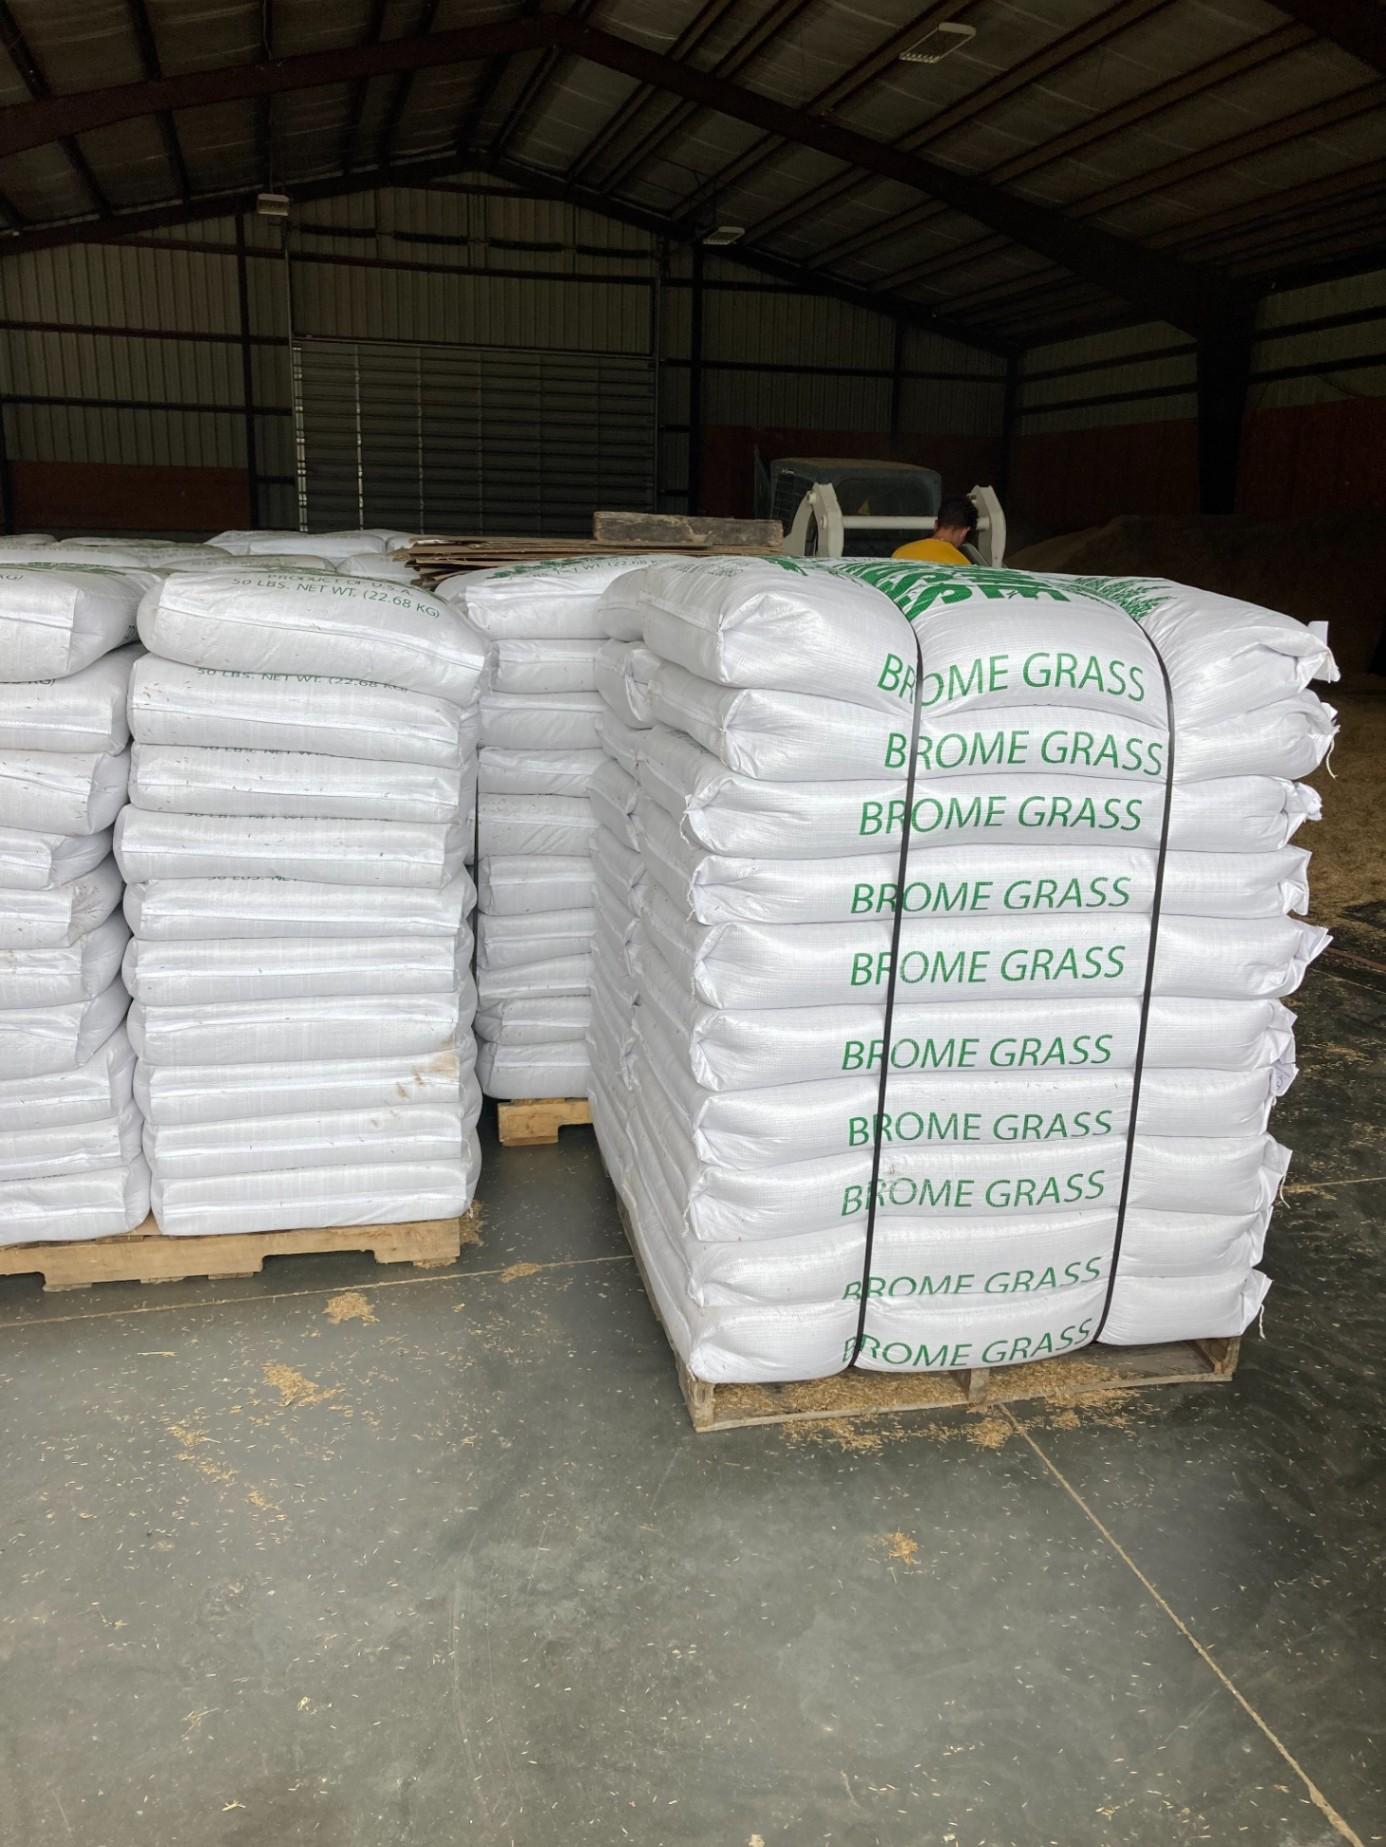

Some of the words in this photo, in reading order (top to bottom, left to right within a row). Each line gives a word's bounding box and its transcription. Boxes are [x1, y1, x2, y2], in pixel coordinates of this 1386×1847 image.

[256, 579, 290, 591] LBS.
[296, 583, 328, 593] NET
[332, 586, 356, 598] WT.
[363, 590, 412, 609] (22.68
[416, 602, 440, 618] KG)
[877, 653, 1009, 707] BROME
[1022, 652, 1145, 702] GRASS
[884, 730, 1030, 769] BROME
[1040, 730, 1163, 776] GRASS
[859, 796, 1006, 836] BROME
[1017, 796, 1143, 831] GRASS
[850, 881, 993, 914] BROME
[1002, 876, 1131, 910] GRASS
[1000, 945, 1126, 982] GRASS
[989, 1034, 1113, 1068] GRASS
[848, 1111, 982, 1147] BROME
[993, 1109, 1112, 1141] GRASS
[841, 1177, 974, 1216] BROME
[984, 1169, 1105, 1208] GRASS
[984, 1256, 1101, 1293] GRASS
[981, 1317, 1093, 1364] GRASS
